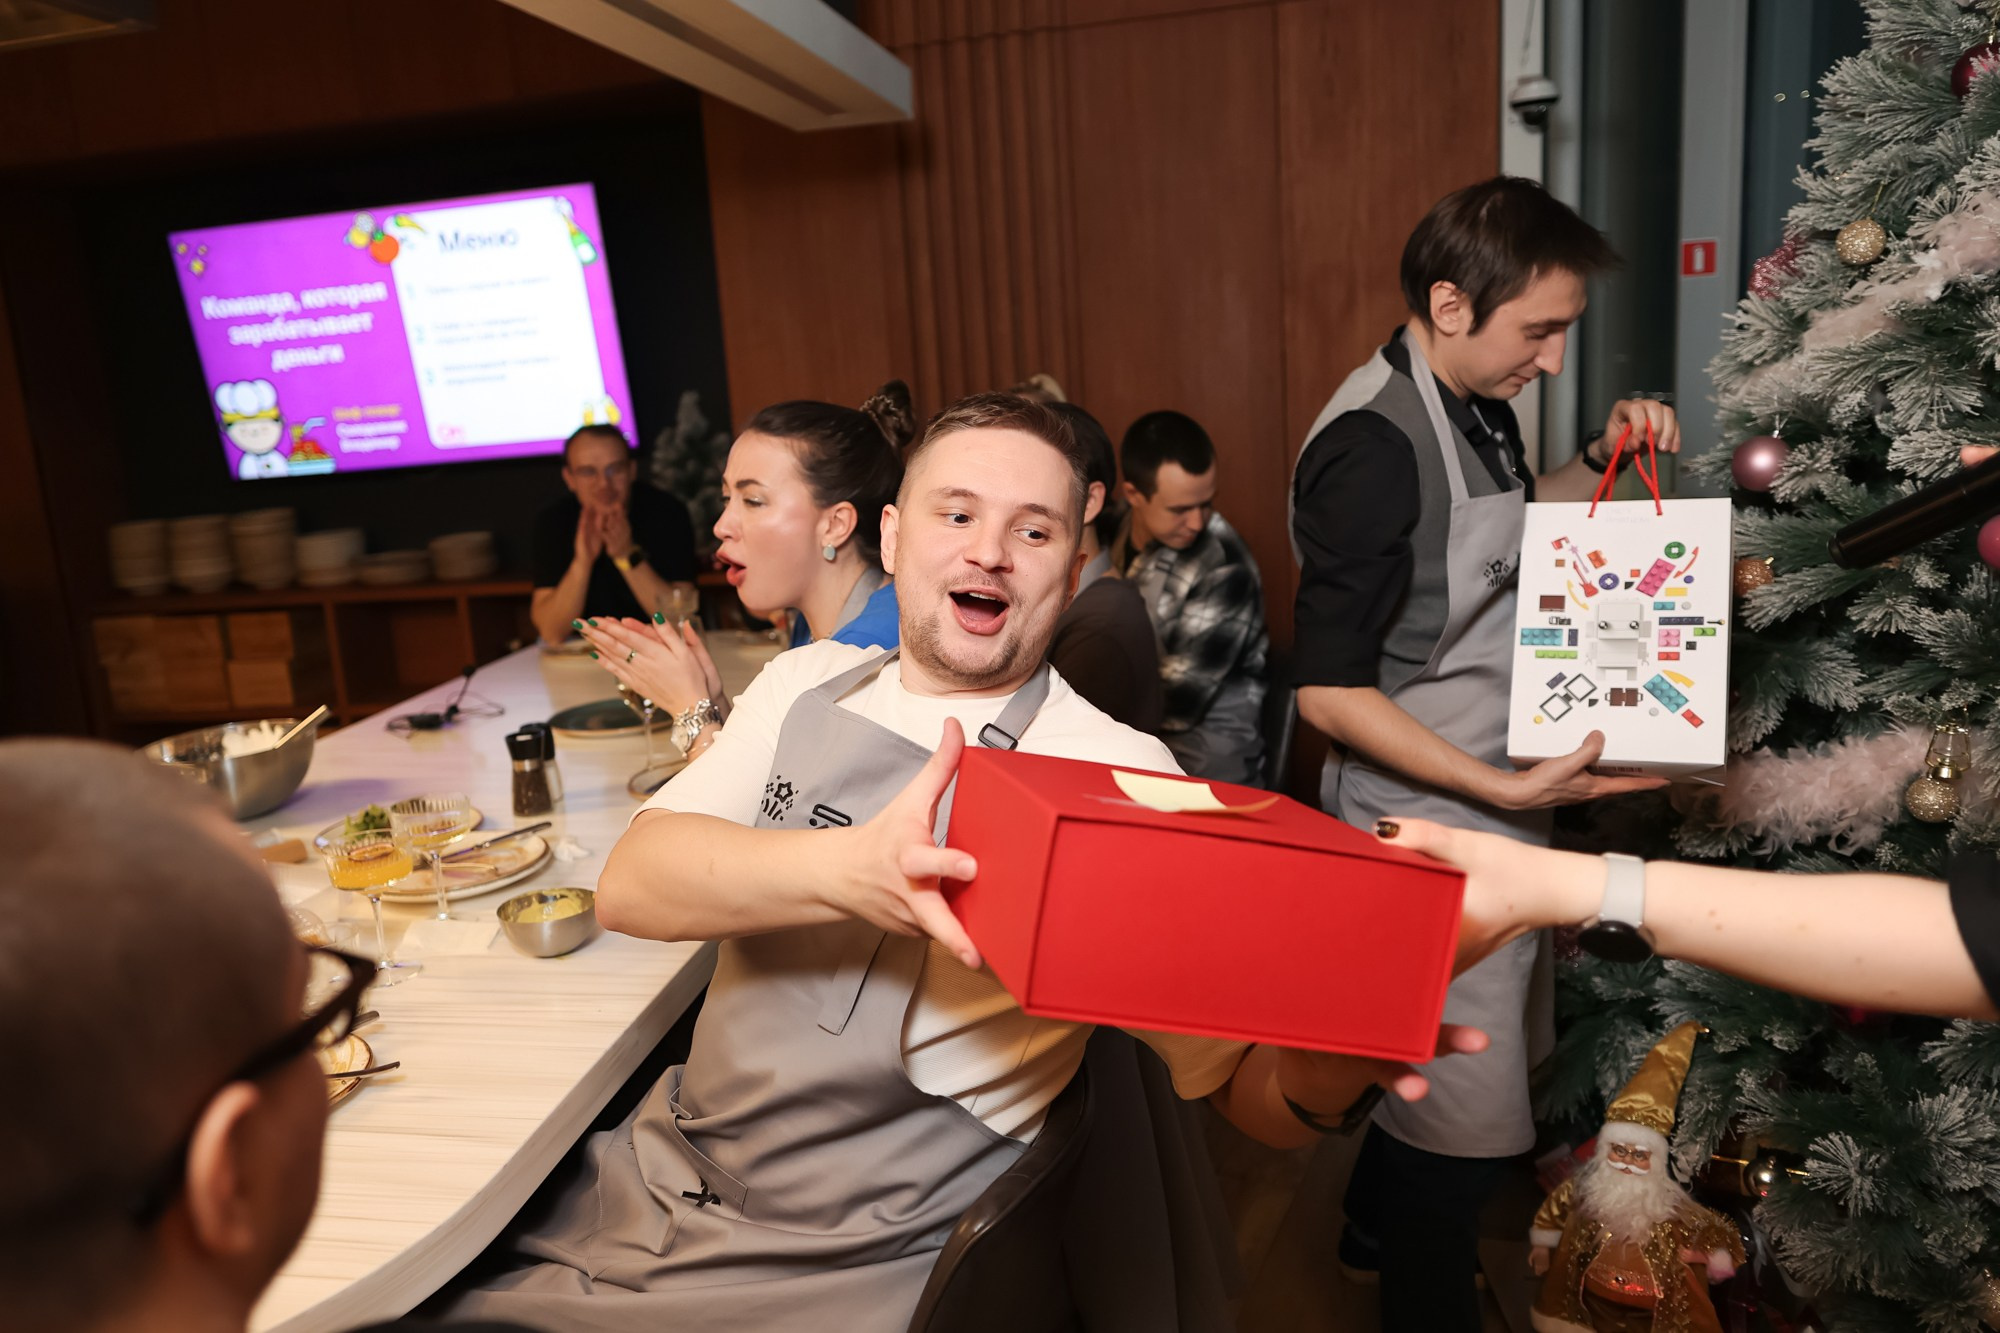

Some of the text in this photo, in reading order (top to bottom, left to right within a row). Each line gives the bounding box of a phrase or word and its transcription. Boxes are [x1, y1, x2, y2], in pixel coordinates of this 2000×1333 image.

[438, 228, 520, 252] Меню
[201, 281, 388, 320] Команда, которая
[228, 311, 374, 348] зарабатывает
[271, 343, 346, 373] деньги
